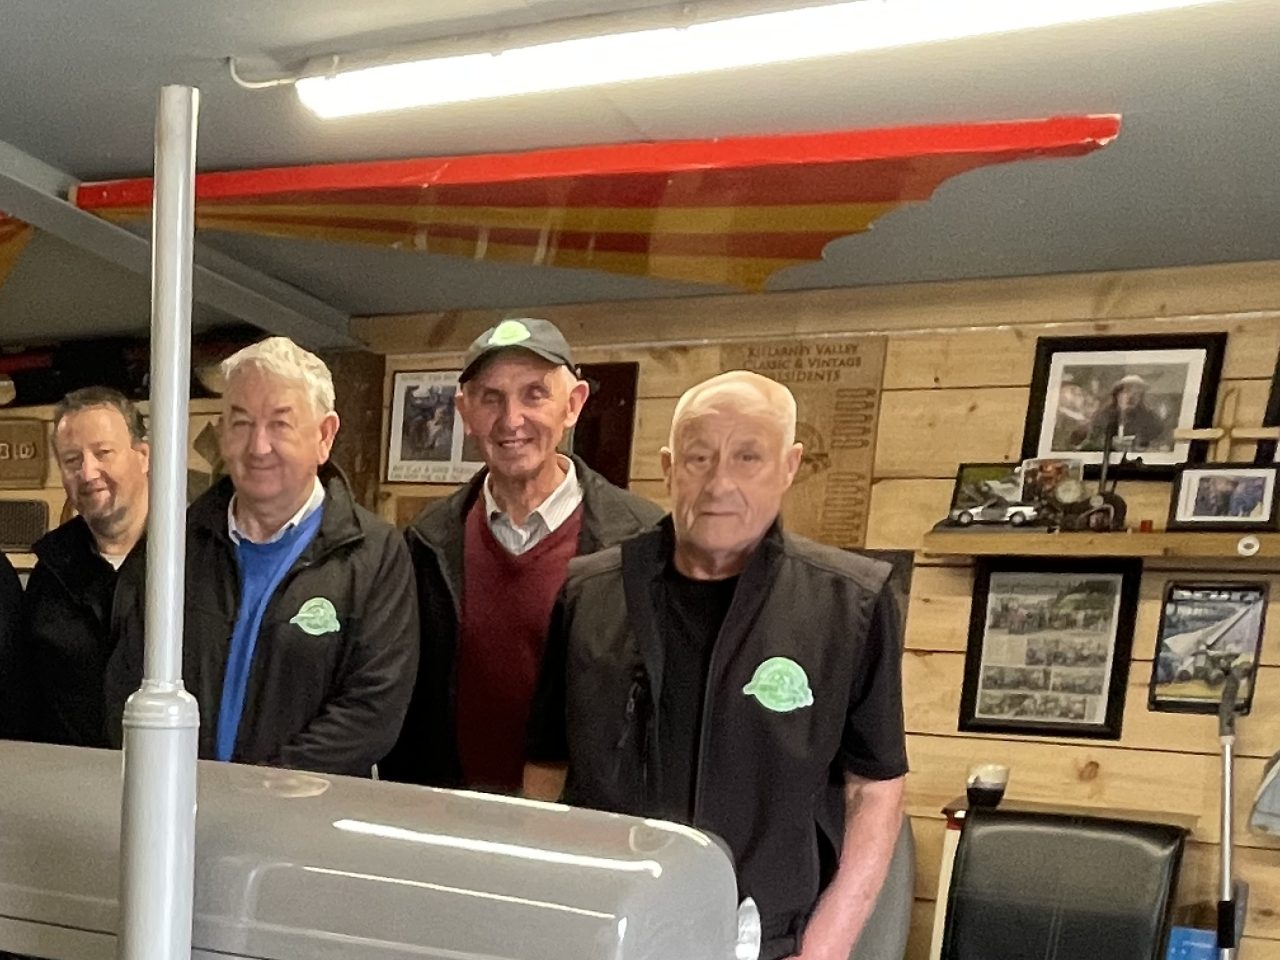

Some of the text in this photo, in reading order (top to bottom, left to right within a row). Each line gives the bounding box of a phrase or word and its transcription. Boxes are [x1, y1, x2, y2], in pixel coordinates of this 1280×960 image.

[815, 342, 859, 356] VALLEY
[742, 359, 792, 370] CLASSIC
[807, 355, 862, 369] VINTAGE
